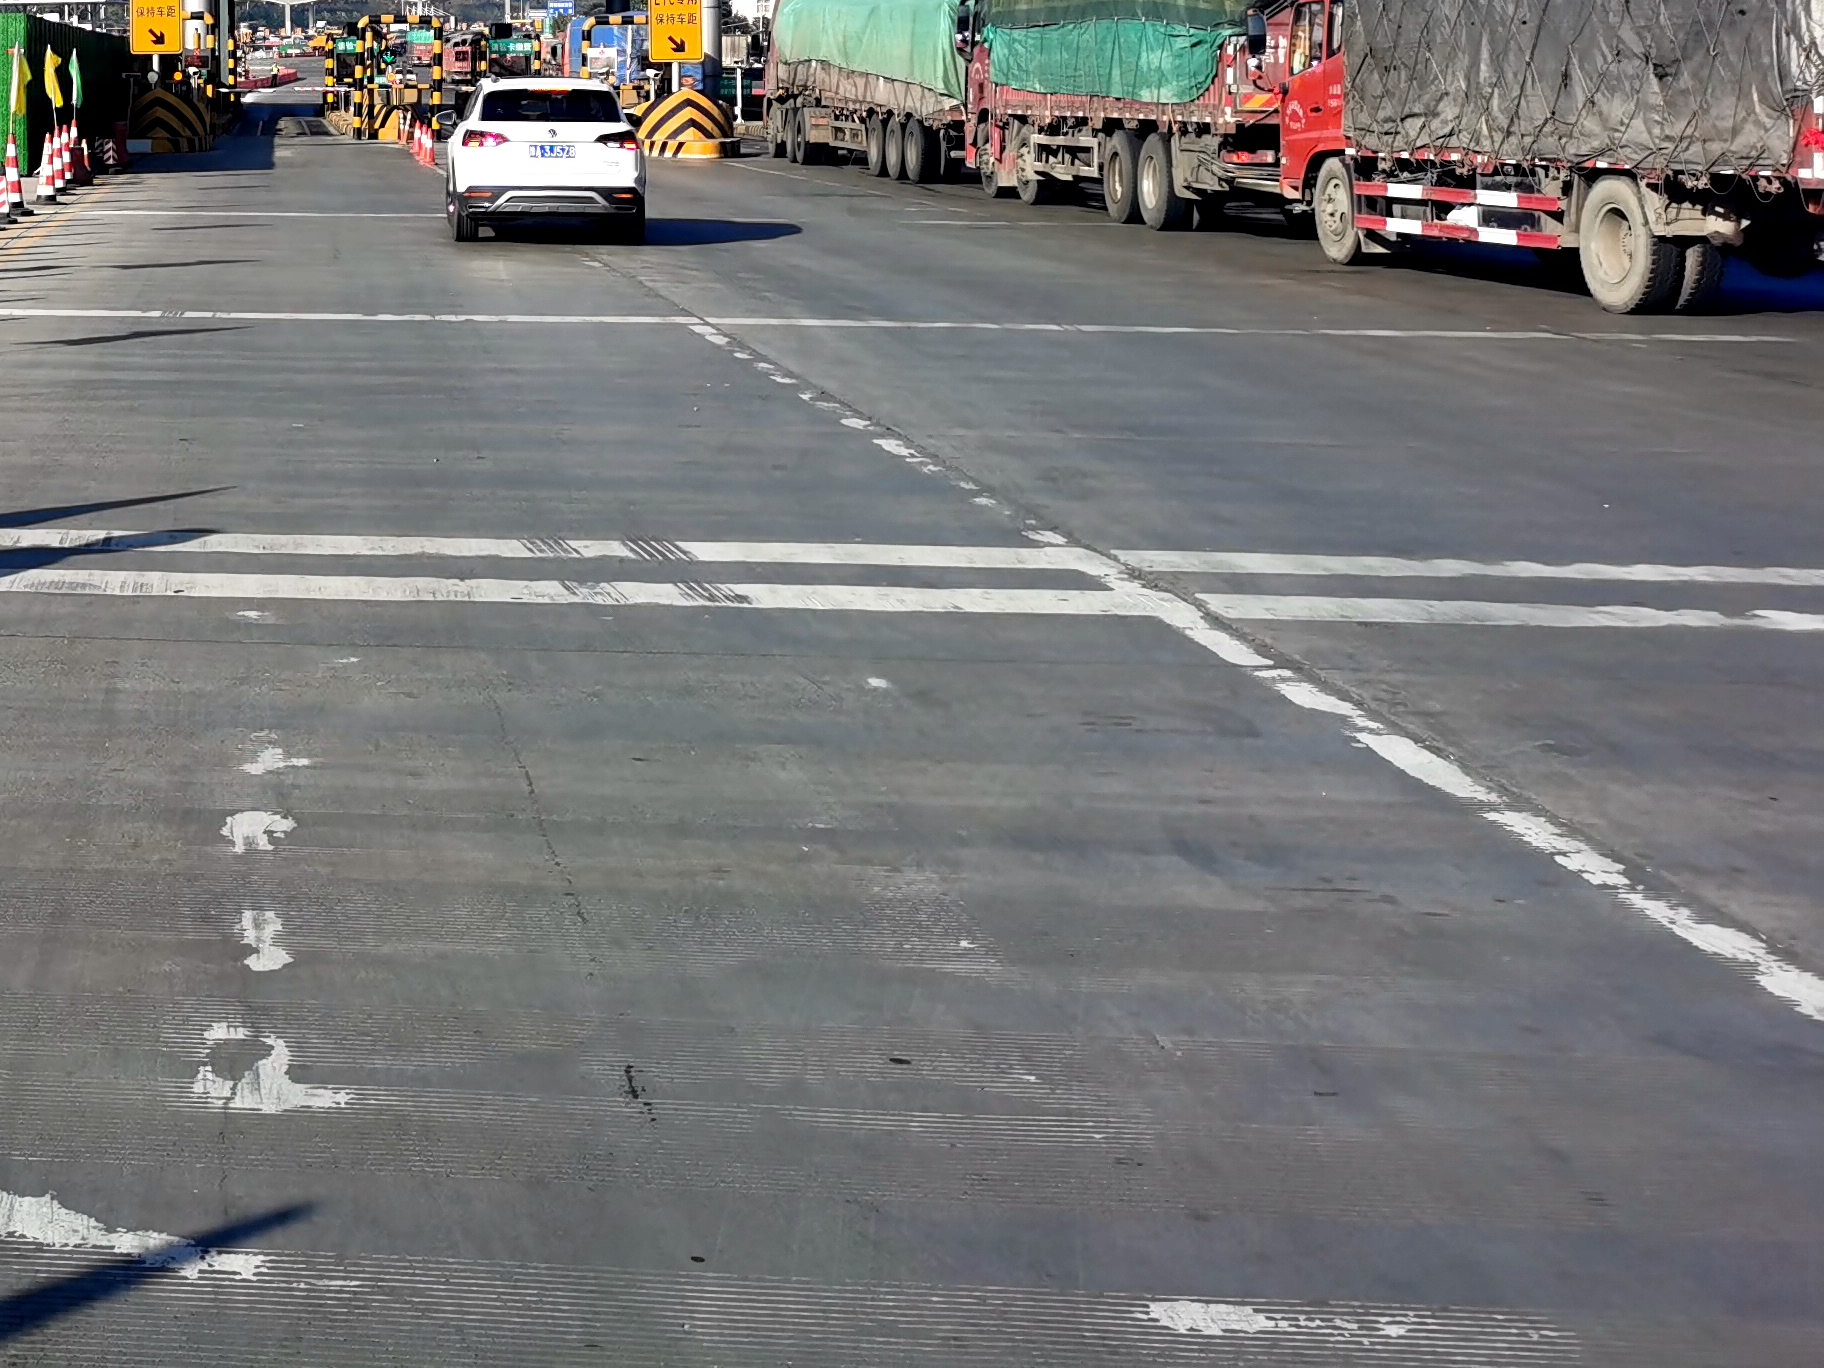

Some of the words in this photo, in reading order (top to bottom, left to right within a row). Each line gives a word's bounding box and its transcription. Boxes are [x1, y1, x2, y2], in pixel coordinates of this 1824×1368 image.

[135, 5, 176, 18] 保持车距
[654, 12, 698, 25] 保持车距
